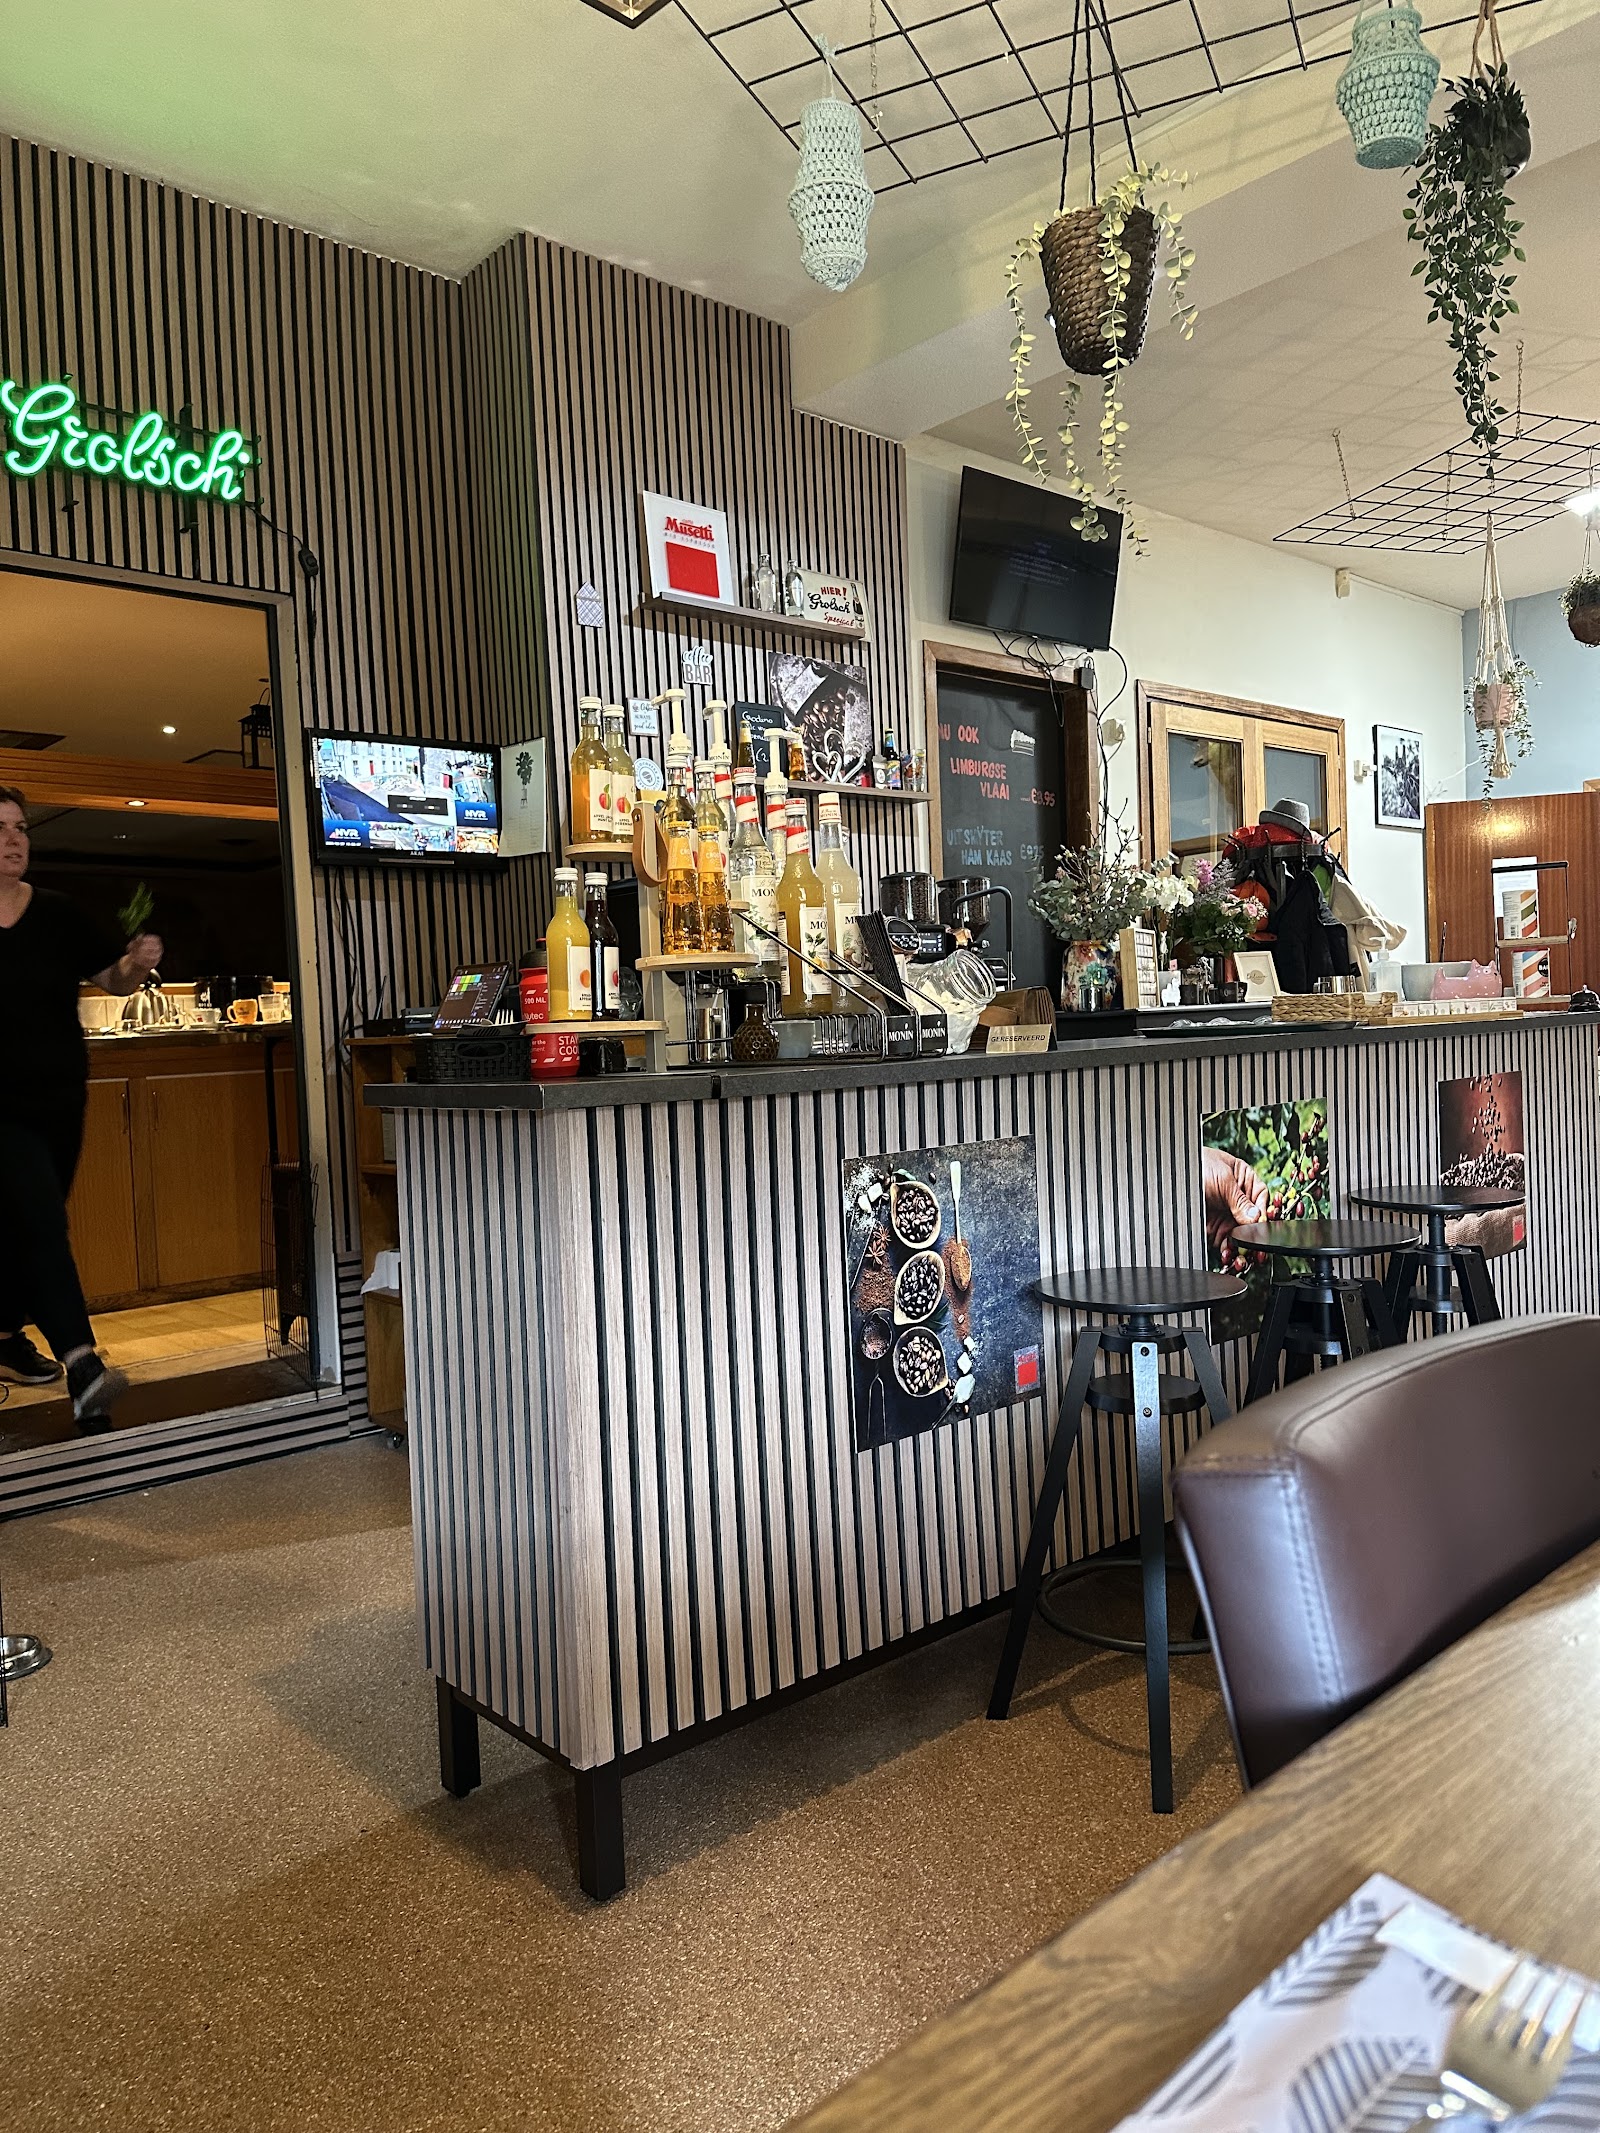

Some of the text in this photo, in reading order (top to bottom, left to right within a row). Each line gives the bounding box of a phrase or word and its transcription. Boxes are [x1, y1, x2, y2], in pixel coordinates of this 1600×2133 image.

[0, 379, 251, 500] Grolsch
[664, 516, 715, 542] Musetti
[807, 592, 851, 614] Grolsch
[820, 586, 848, 601] HIER!
[682, 645, 713, 665] coffee
[684, 663, 712, 683] BAR
[957, 724, 980, 744] OOK
[950, 756, 1007, 780] LIMBURGSE
[980, 782, 1010, 801] VLAAI
[961, 848, 1012, 866] HAM KAAS
[535, 996, 547, 1004] ML
[990, 1034, 1046, 1043] GERESERVEERD
[558, 1045, 580, 1056] COO
